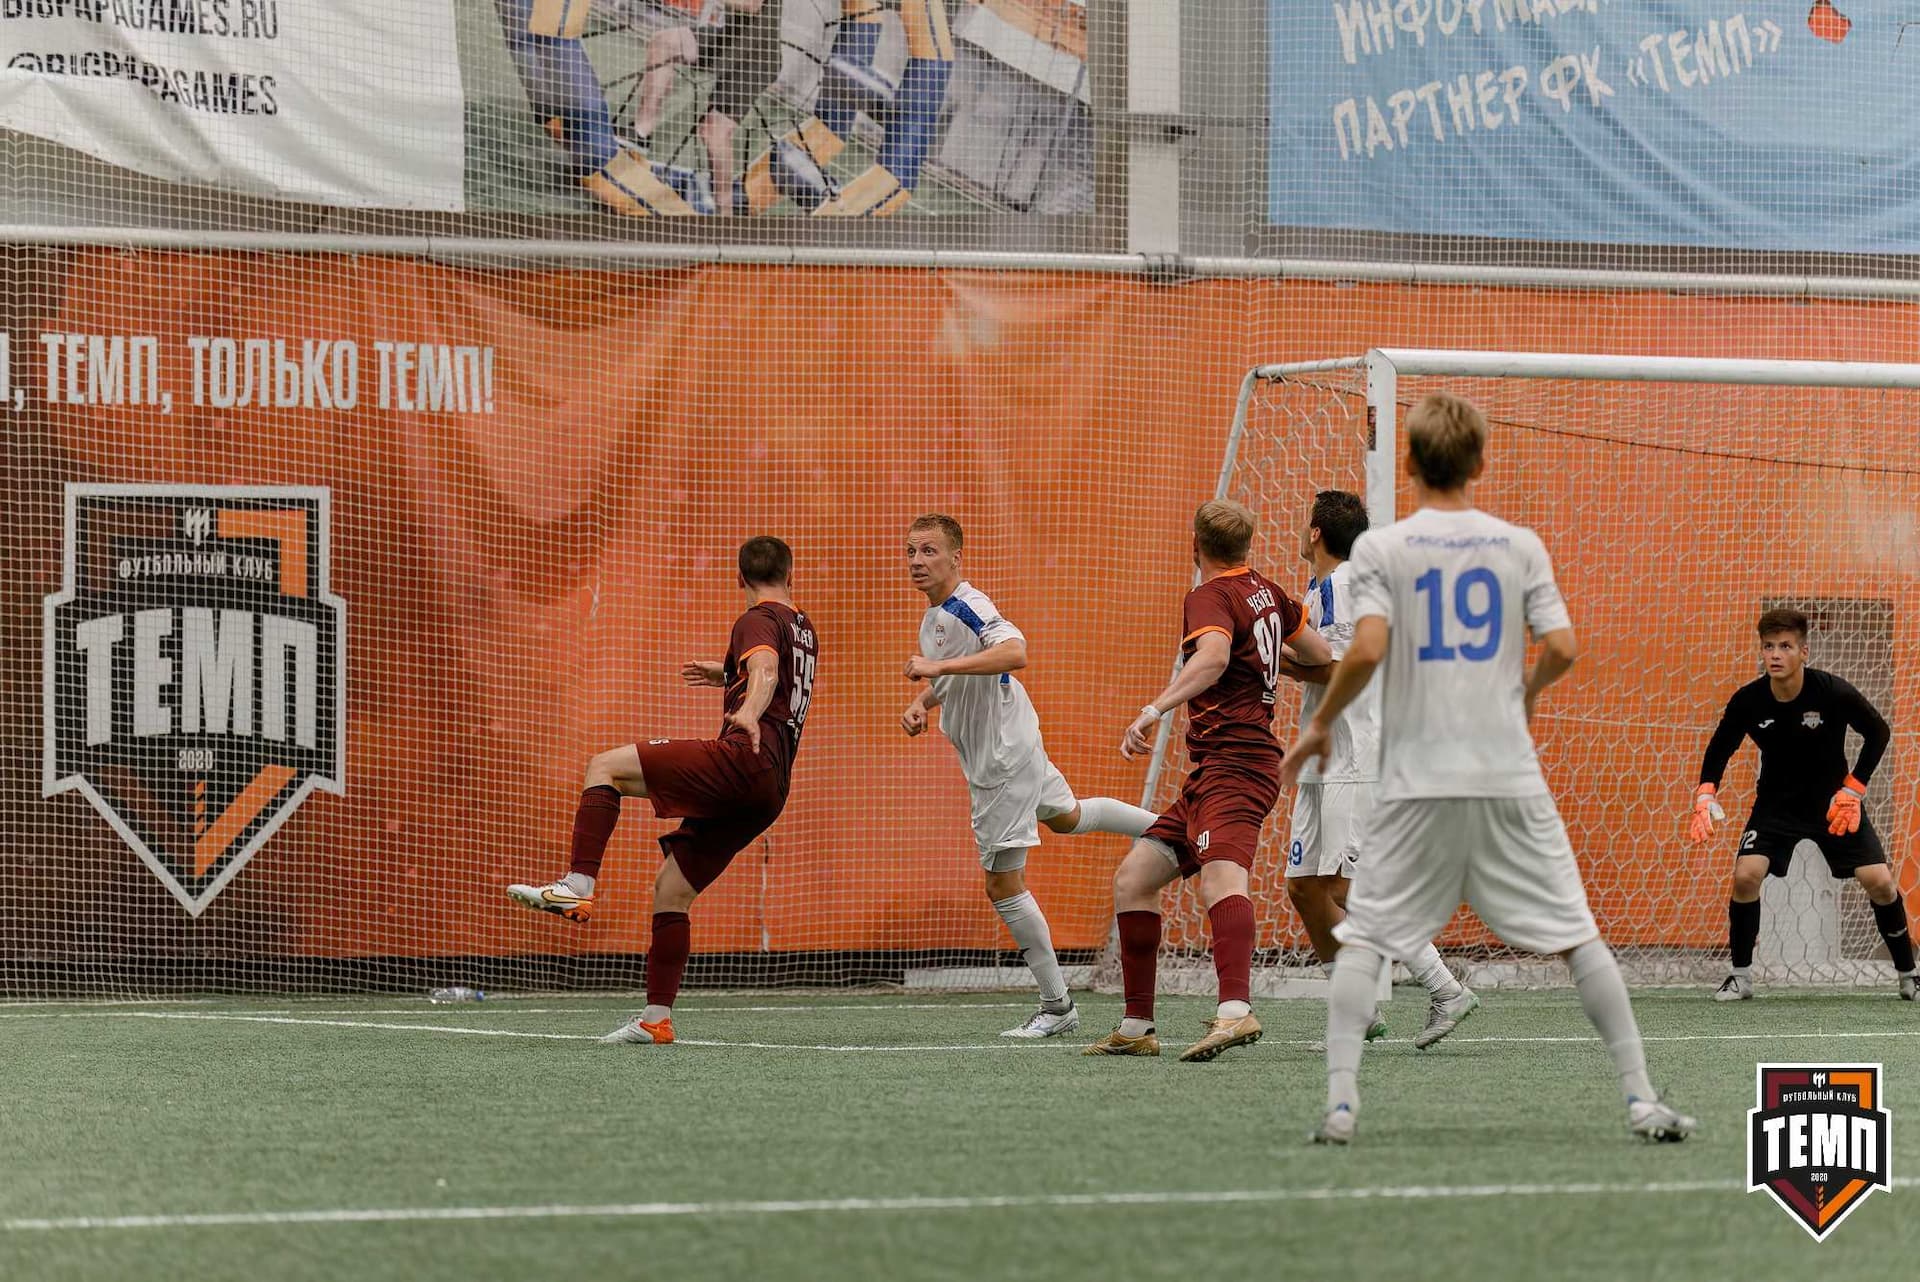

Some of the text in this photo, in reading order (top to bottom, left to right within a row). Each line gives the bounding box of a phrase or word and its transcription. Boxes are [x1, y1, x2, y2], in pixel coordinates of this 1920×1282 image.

[1334, 14, 1783, 160] ПАРТНЕР ФК «ТЕМП»
[40, 333, 172, 415] ТЕМП,
[188, 338, 359, 410] ТОЛЬКО
[373, 342, 494, 414] ТЕМП!
[119, 552, 273, 580] ФУТБОЛЬНЫЙ КЛУБ
[1253, 612, 1282, 690] 90
[1415, 566, 1503, 662] 19
[76, 607, 318, 748] ТЕМП
[789, 646, 815, 724] 55
[178, 750, 214, 770] 2020
[1197, 830, 1210, 854] 90
